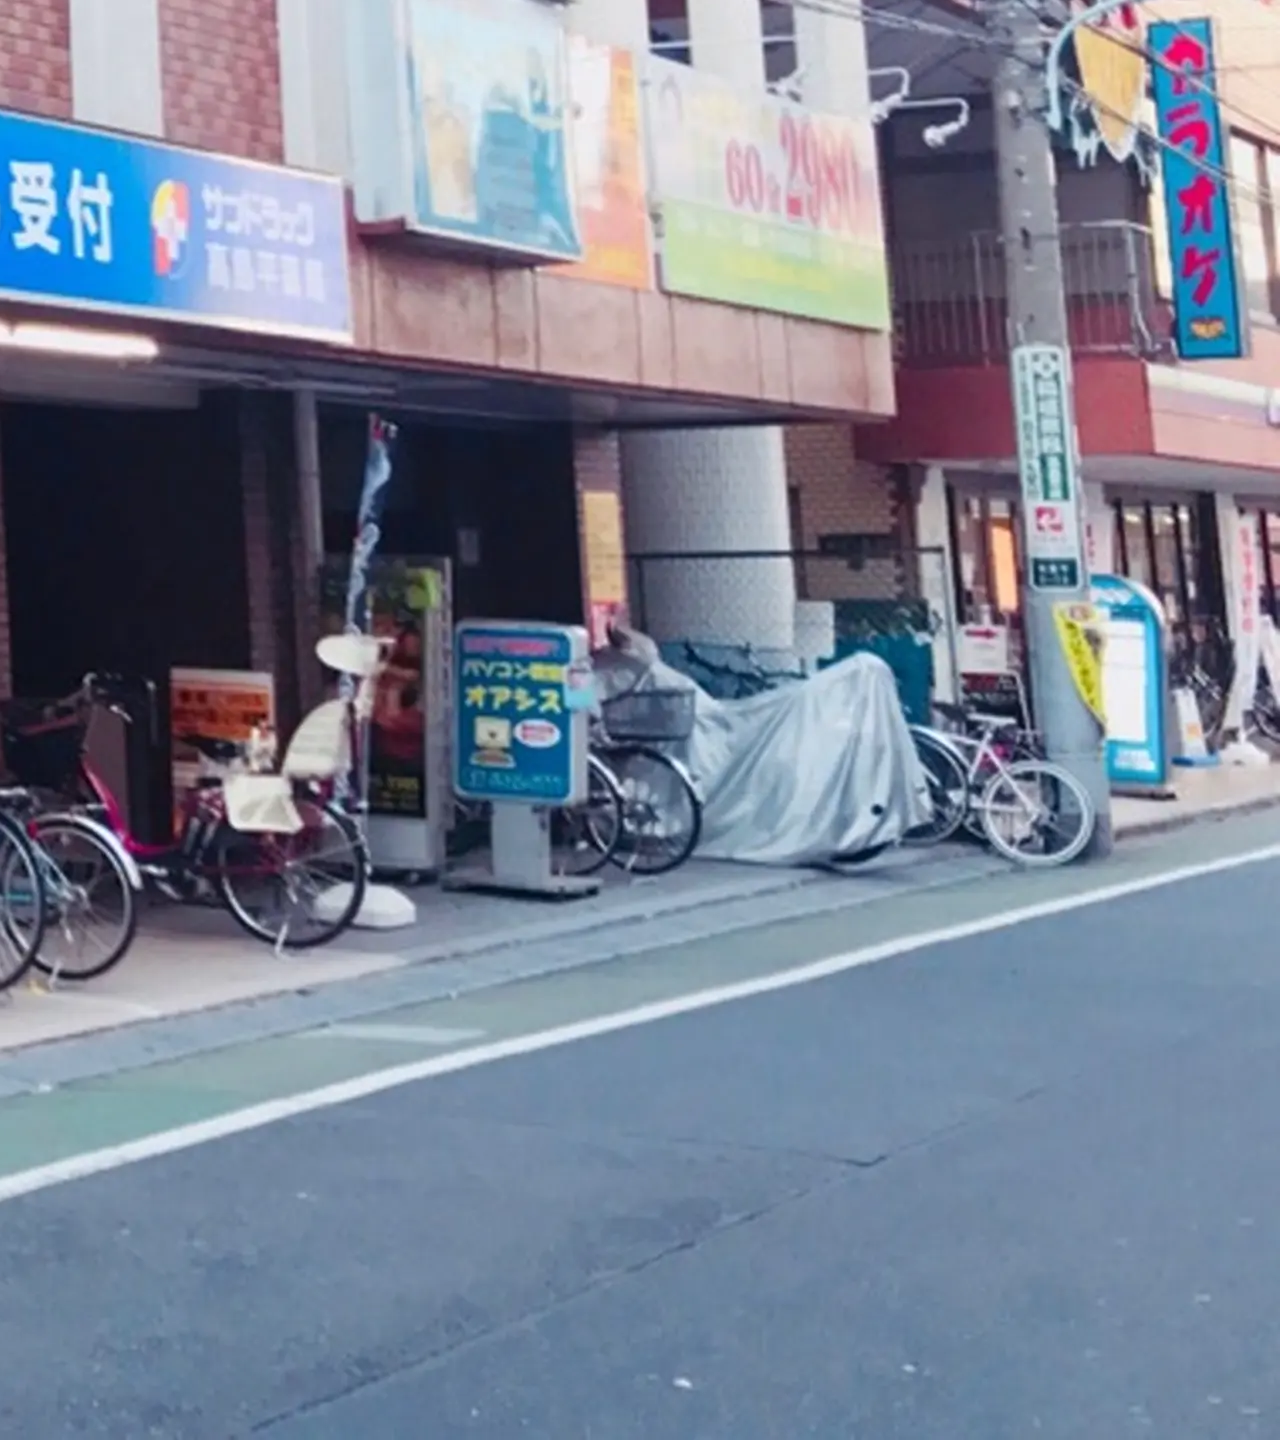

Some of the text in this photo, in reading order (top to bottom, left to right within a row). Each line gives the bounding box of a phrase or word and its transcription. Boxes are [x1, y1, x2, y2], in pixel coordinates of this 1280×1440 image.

[1164, 35, 1220, 305] カラオケ
[465, 684, 561, 713] オアシス
